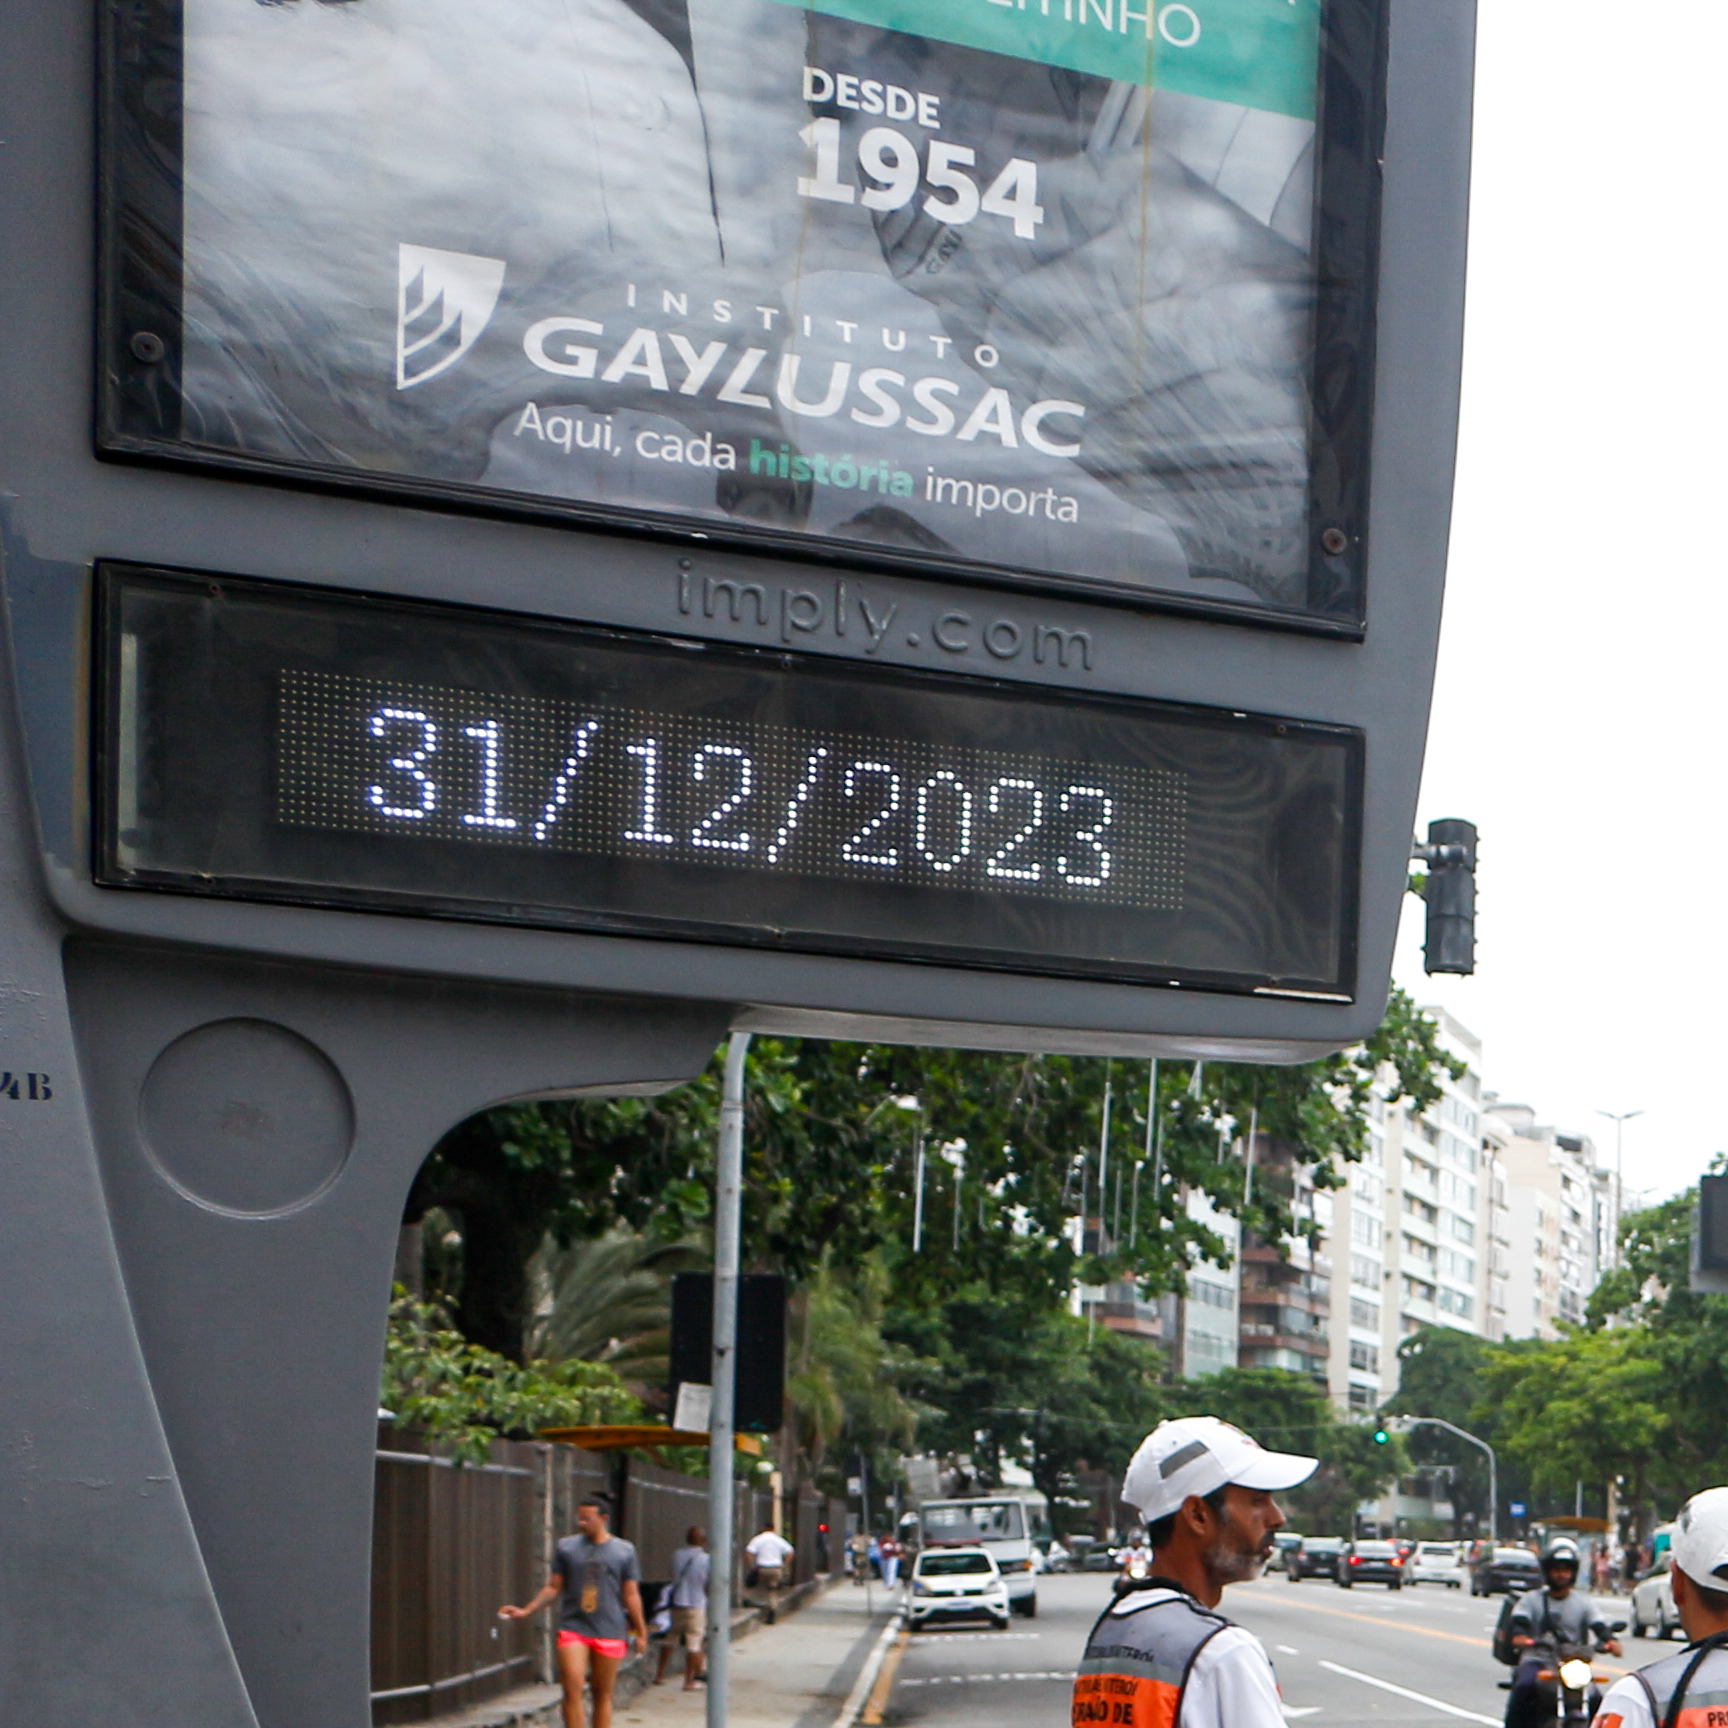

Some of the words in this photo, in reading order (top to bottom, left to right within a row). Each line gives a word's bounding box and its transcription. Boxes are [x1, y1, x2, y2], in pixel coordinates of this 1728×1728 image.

[803, 66, 941, 130] DESDE
[797, 117, 1044, 241] 1954
[627, 284, 999, 369] INSTITUTO
[522, 316, 1087, 458] GAYLUSSAC
[513, 402, 622, 459] Aqui,
[635, 431, 737, 472] cada
[749, 440, 914, 499] história
[925, 466, 1080, 524] importa
[676, 559, 1095, 673] imply.com
[367, 706, 1115, 888] 31/12/2023
[1113, 1702, 1134, 1725] DE
